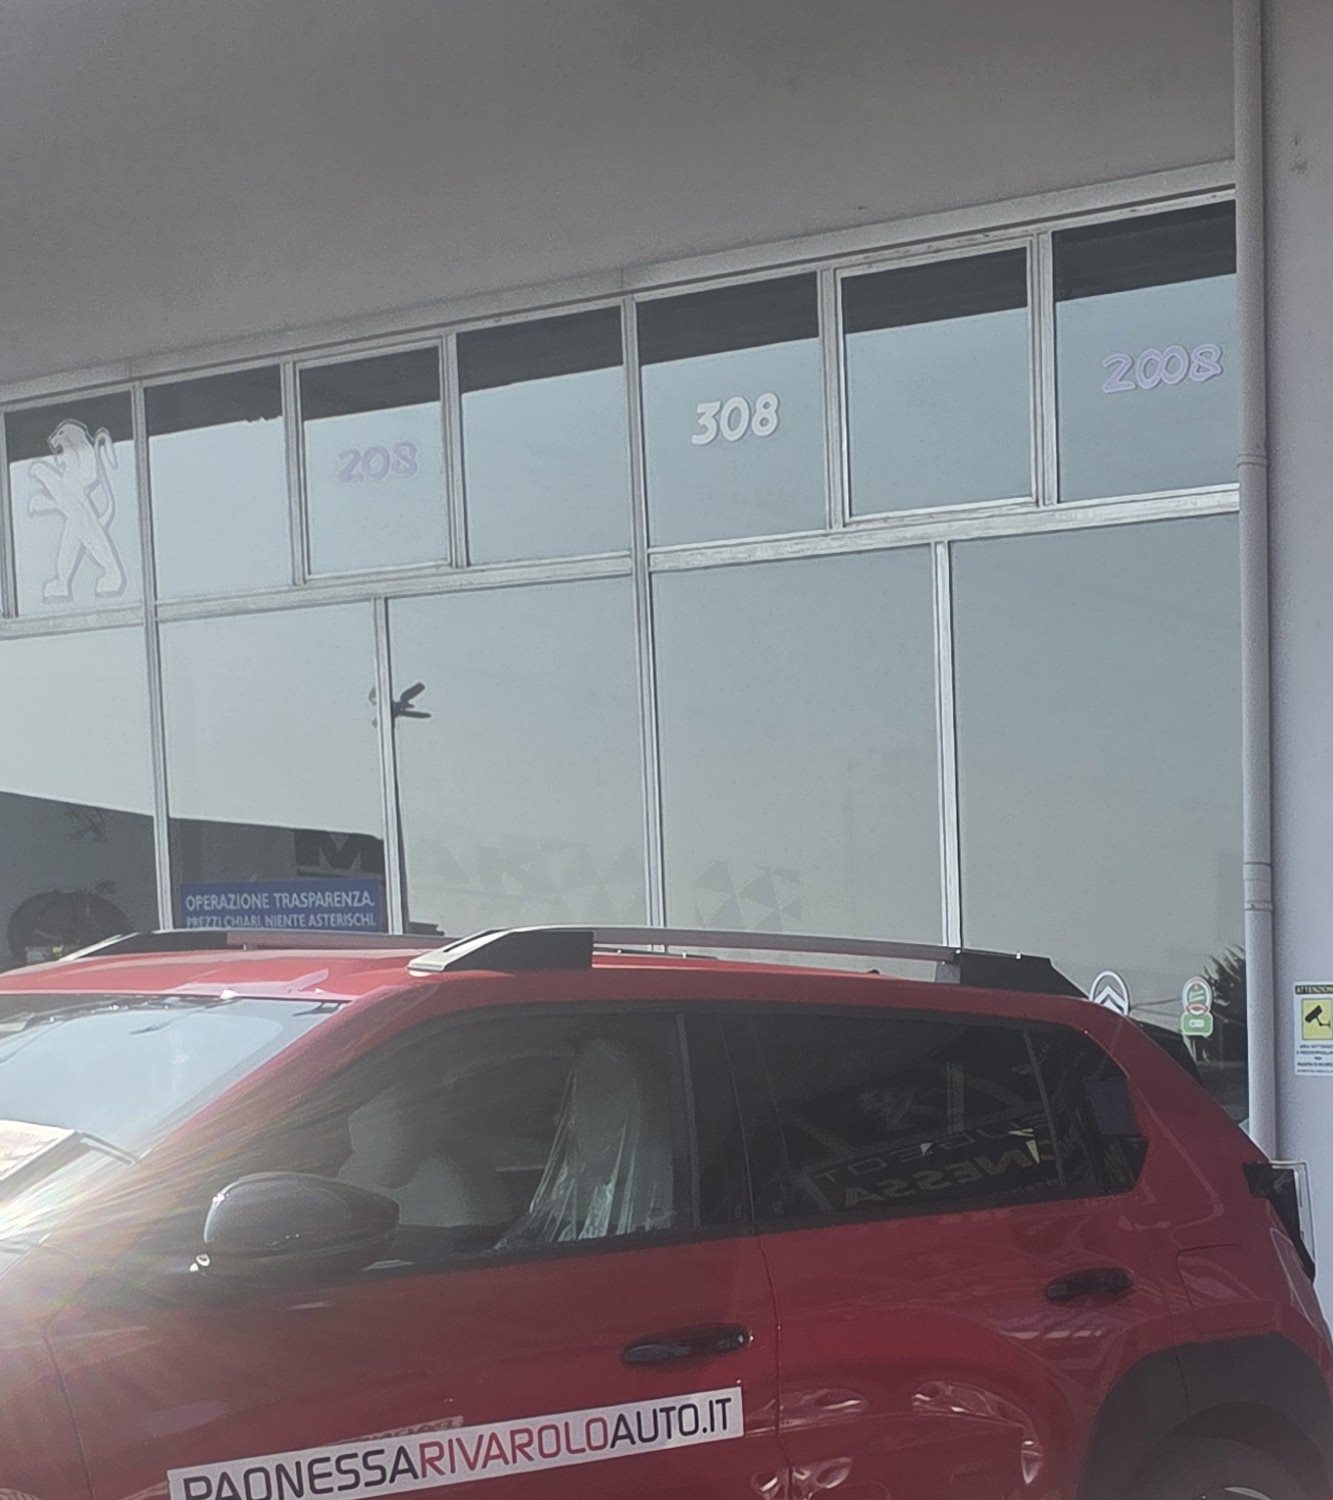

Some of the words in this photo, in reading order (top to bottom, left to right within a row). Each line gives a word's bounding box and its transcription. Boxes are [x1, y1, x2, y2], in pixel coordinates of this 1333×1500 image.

[1101, 343, 1223, 394] 2008
[691, 392, 780, 446] 308
[335, 442, 420, 484] 208
[185, 893, 269, 912] OPERAZIONE
[273, 890, 376, 909] TRASPARENZA.
[264, 914, 306, 928] NIENTE
